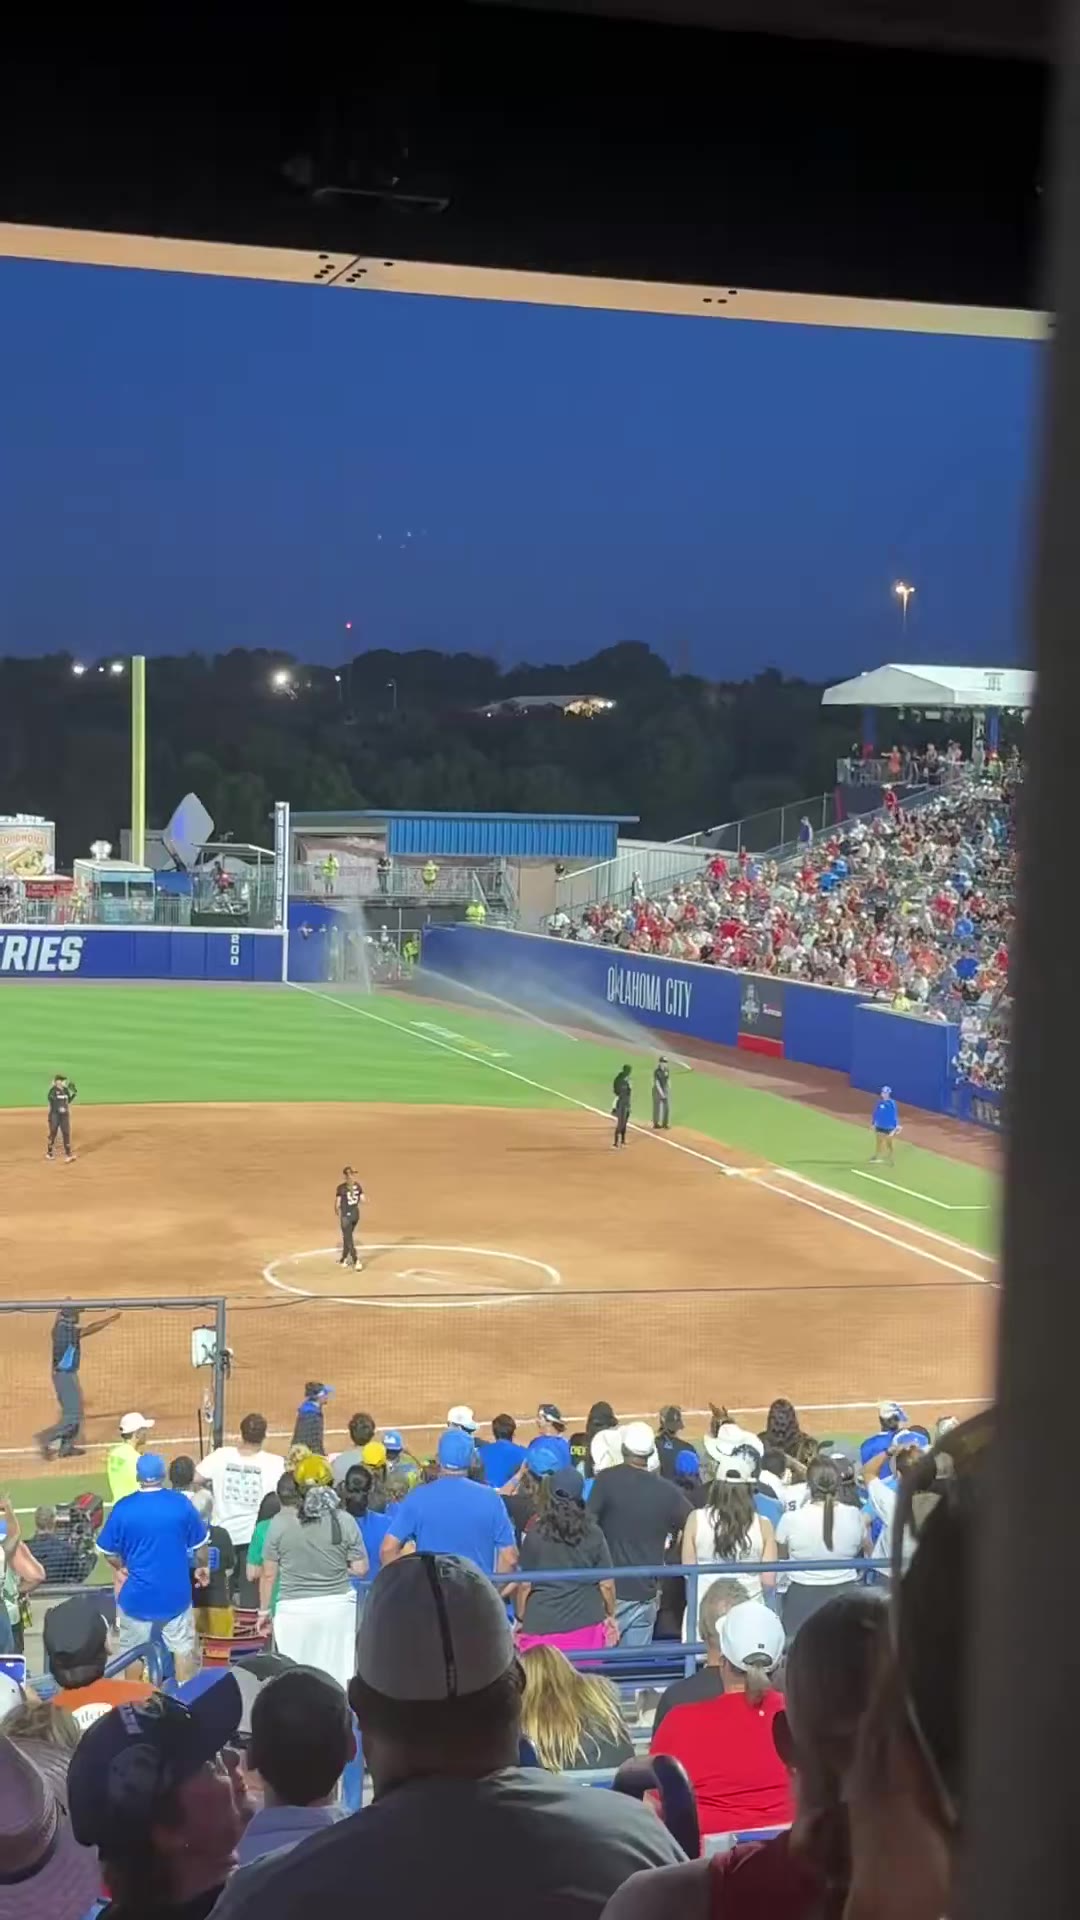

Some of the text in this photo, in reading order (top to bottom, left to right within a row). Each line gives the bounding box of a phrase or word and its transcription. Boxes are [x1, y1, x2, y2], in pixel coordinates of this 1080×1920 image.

[0, 935, 84, 971] RIES
[607, 963, 693, 1018] OKLAHOMA CITY
